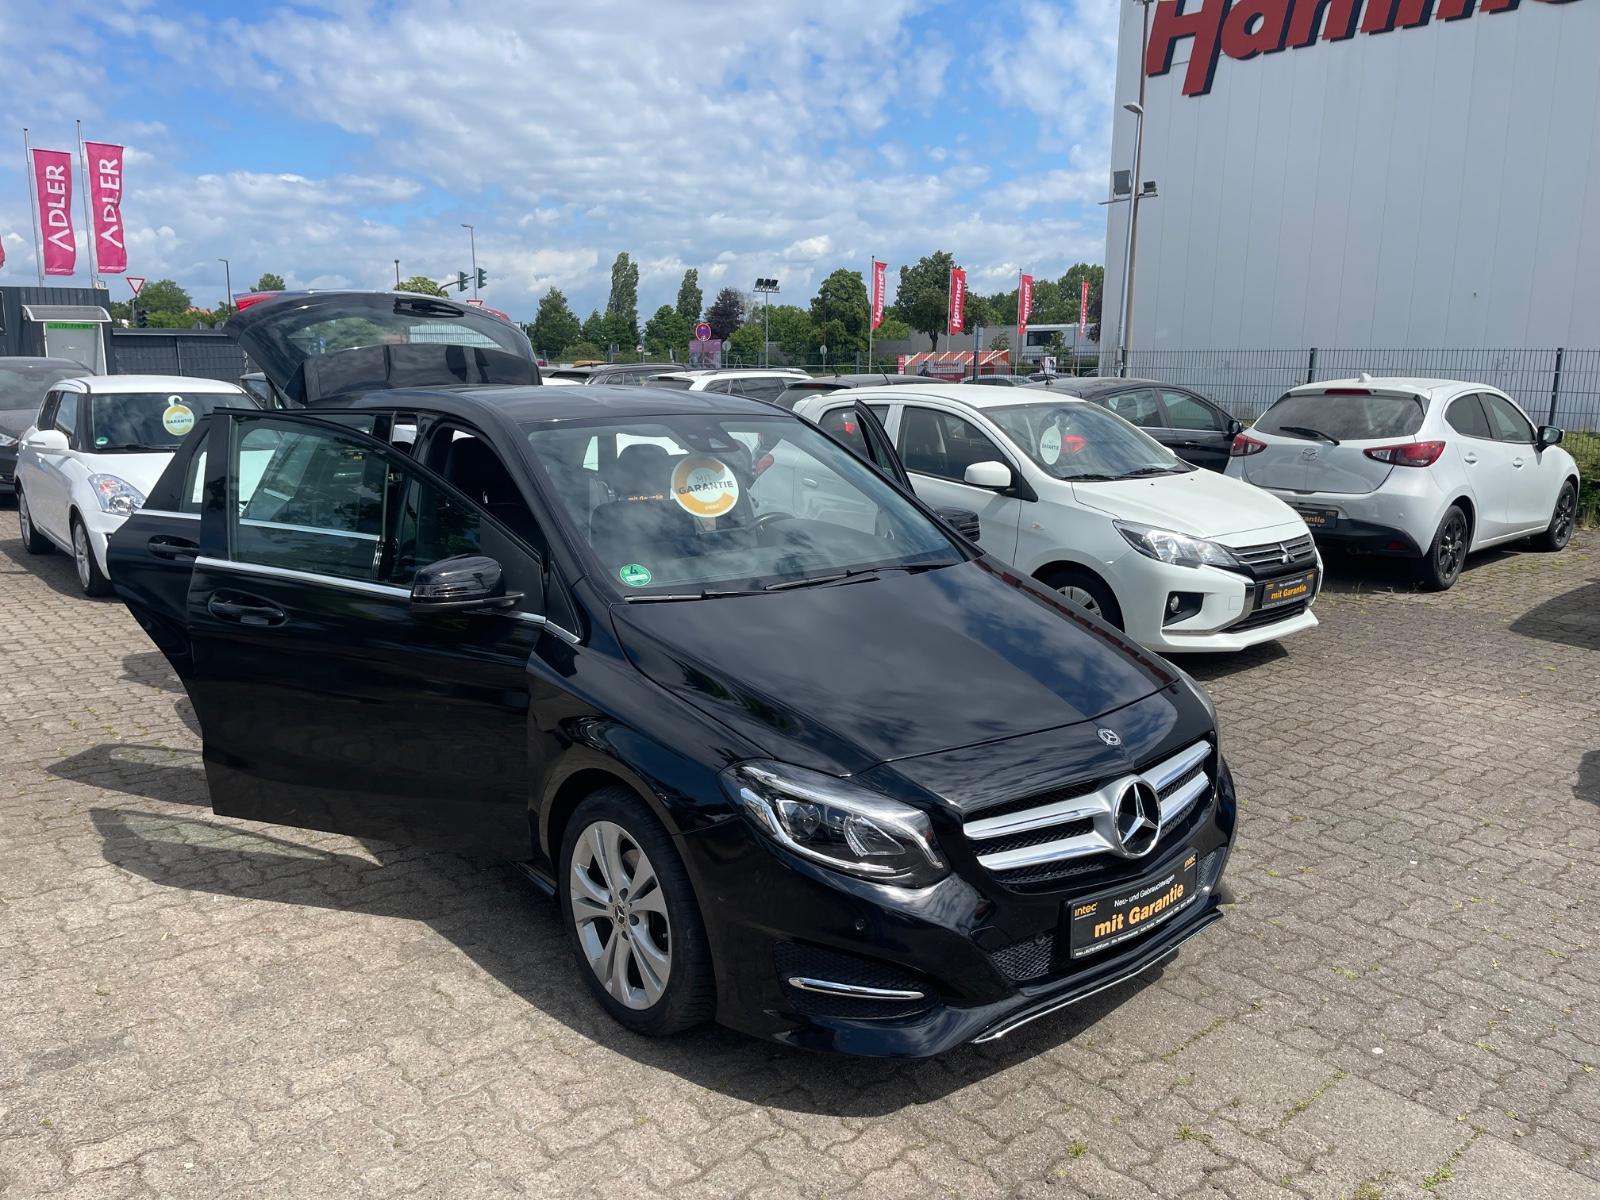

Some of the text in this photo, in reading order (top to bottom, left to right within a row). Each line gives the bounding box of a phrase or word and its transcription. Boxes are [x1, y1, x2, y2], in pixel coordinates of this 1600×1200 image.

[46, 165, 74, 252] ADLER
[100, 158, 123, 249] ADLER
[952, 278, 963, 329] Hammer
[678, 480, 735, 495] GARANTIE
[1283, 583, 1308, 597] Garantie
[1094, 913, 1125, 938] mit
[1128, 883, 1185, 925] Garantie
[1114, 899, 1129, 908] Neu-
[1129, 892, 1140, 903] und
